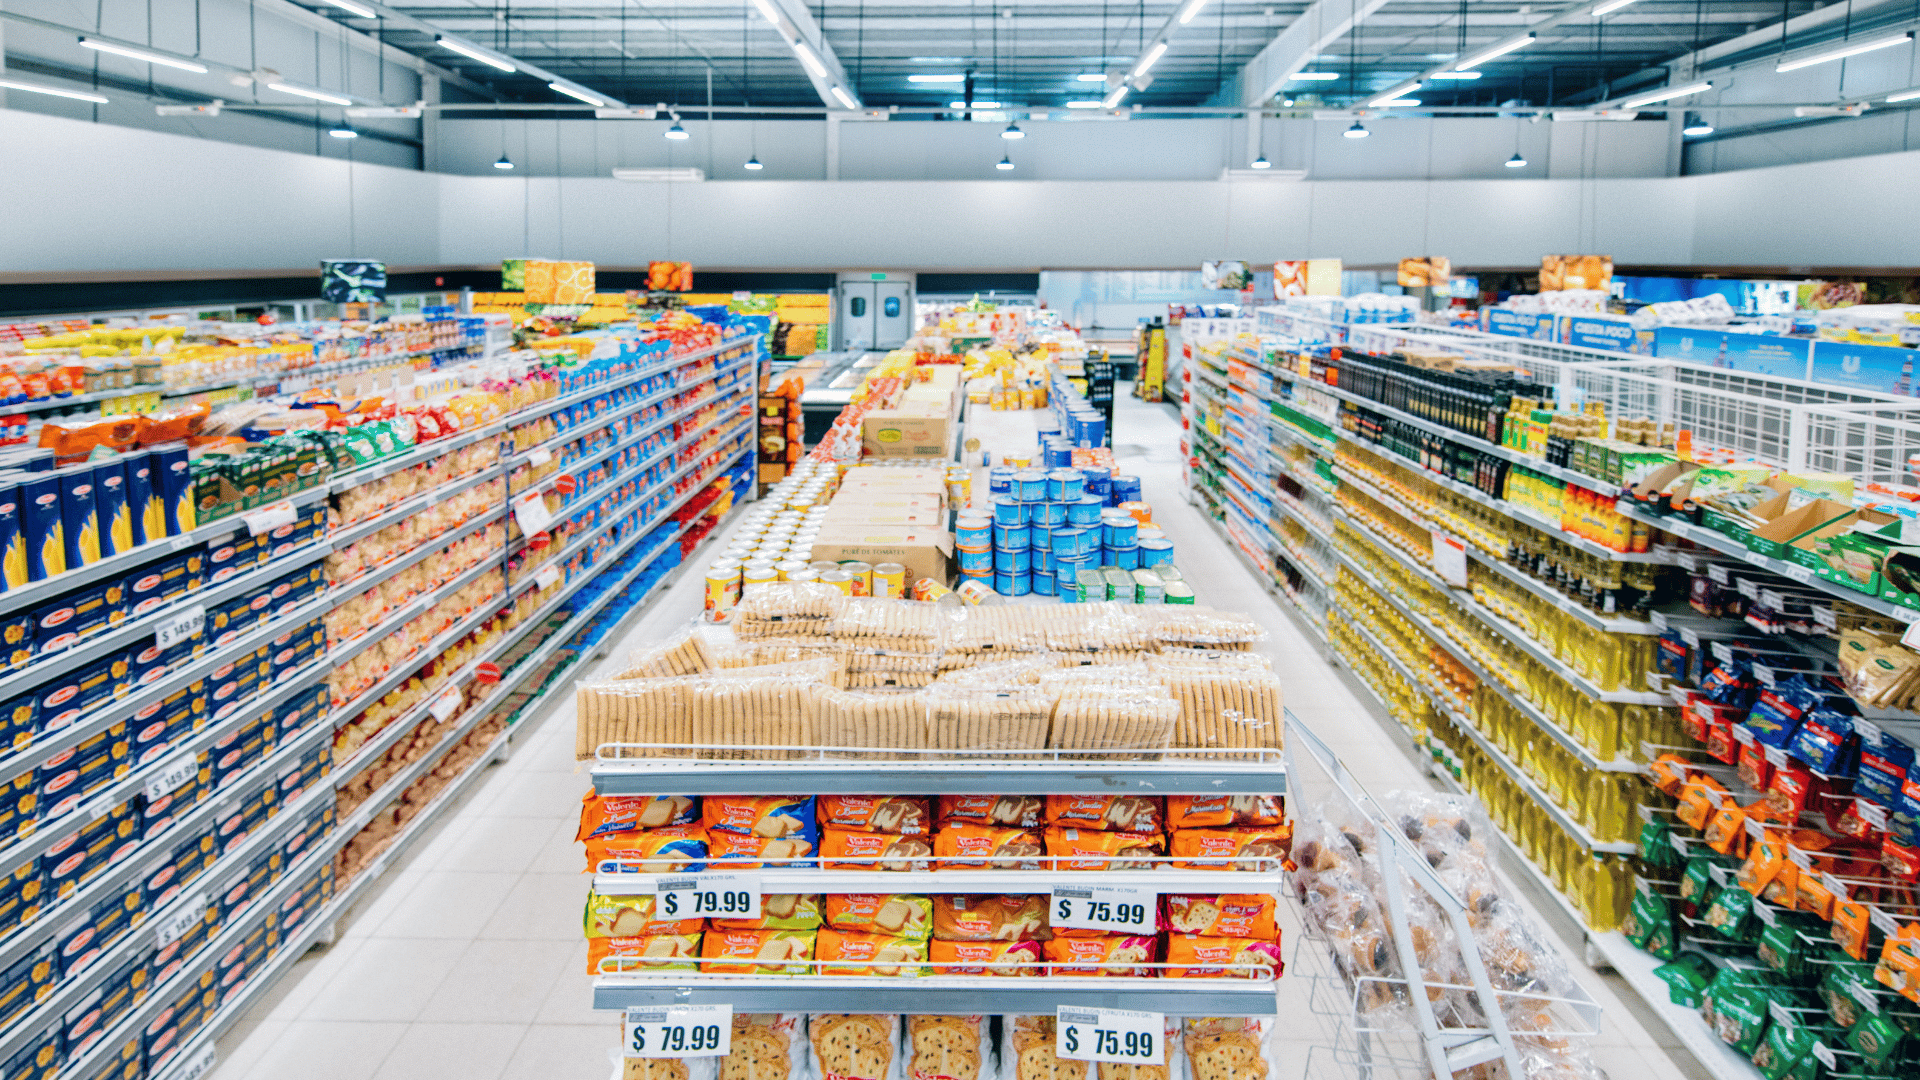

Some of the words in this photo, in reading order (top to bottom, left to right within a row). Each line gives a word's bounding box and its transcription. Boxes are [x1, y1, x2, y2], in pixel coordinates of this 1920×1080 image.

[162, 631, 170, 643] $
[165, 762, 196, 788] 149.99
[605, 799, 640, 813] Valente
[848, 837, 881, 847] Valente
[957, 838, 991, 848] Valente
[1201, 838, 1233, 848] Valente
[665, 892, 678, 915] $
[693, 891, 750, 912] 79.99
[1058, 899, 1071, 920] $
[1087, 902, 1144, 924] 75.99
[609, 938, 643, 947] Valente
[725, 935, 758, 946] Valente
[1071, 942, 1104, 952] Valente
[957, 948, 991, 958] Valente
[1196, 949, 1230, 958] Valente
[633, 1025, 646, 1053] $
[661, 1025, 720, 1051] 79.99
[1066, 1025, 1079, 1054] $
[1095, 1029, 1153, 1057] 75.99
